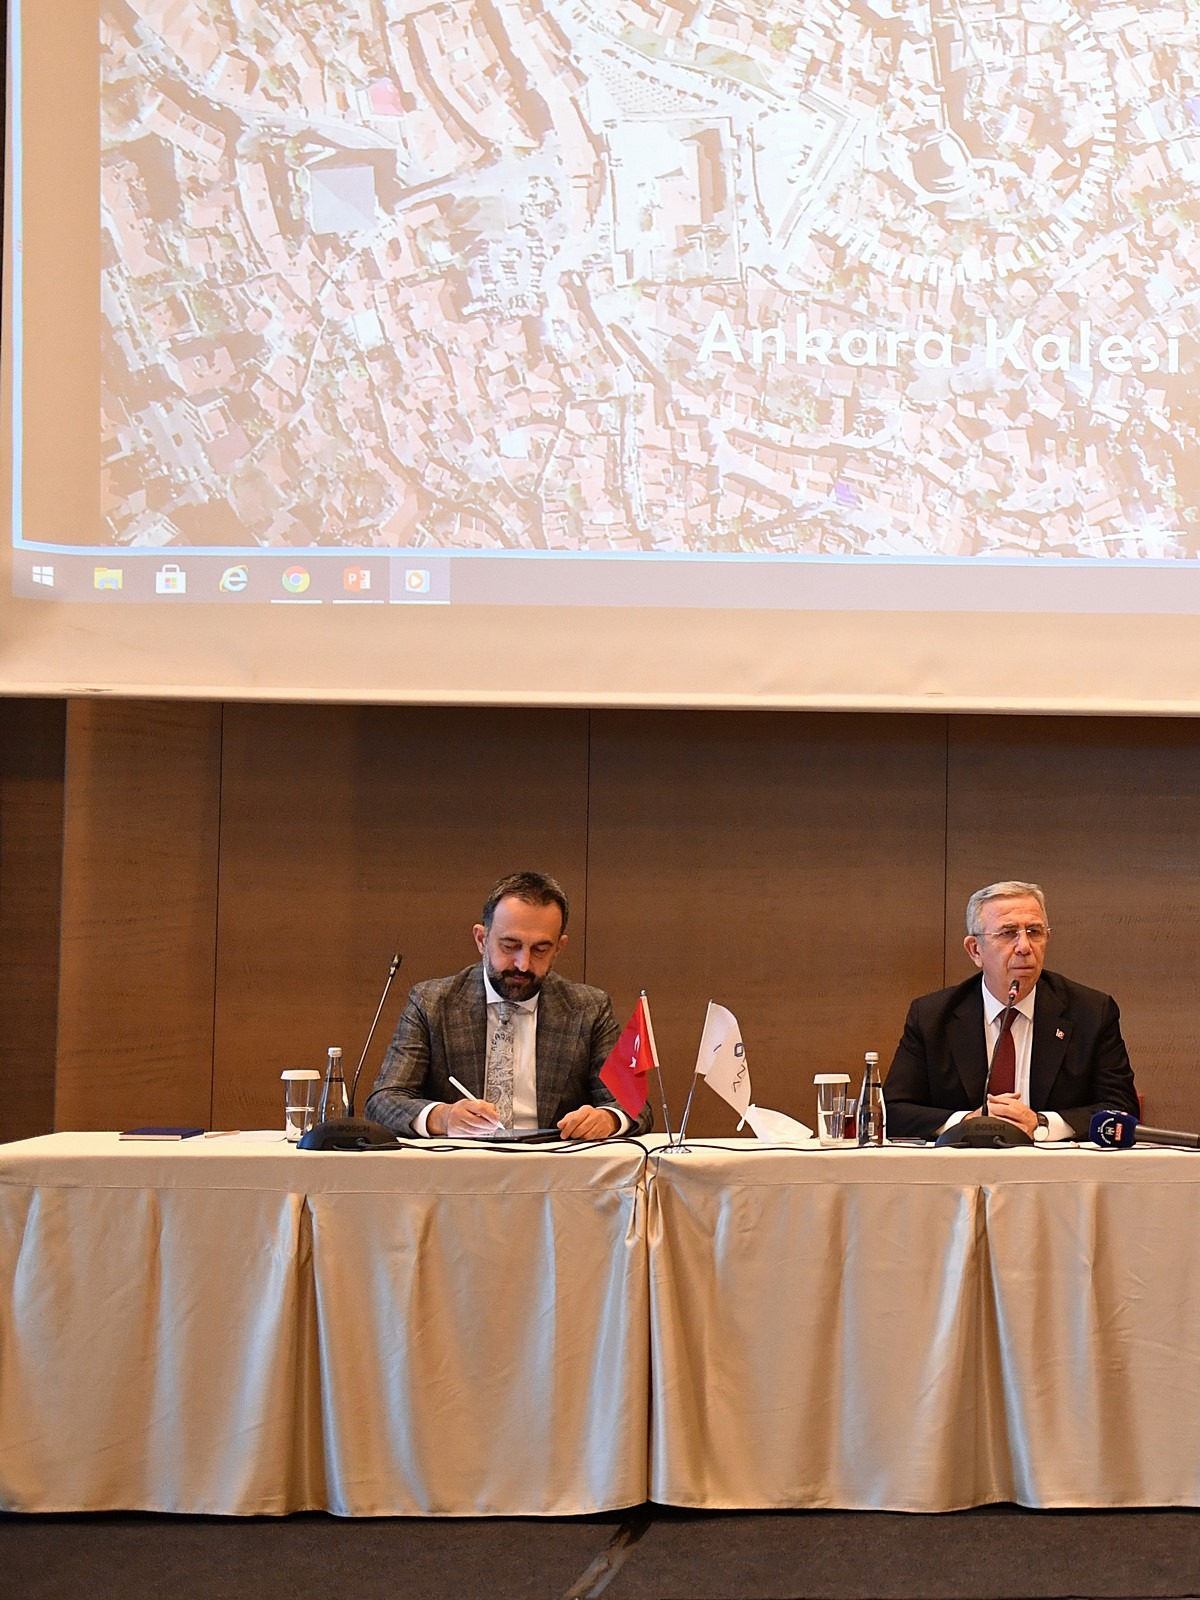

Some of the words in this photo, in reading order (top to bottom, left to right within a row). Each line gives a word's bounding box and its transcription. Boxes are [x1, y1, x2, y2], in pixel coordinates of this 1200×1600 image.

[696, 310, 953, 368] Ankara
[985, 317, 1180, 374] Kalesi
[338, 1124, 370, 1133] BOSCH
[975, 1123, 1006, 1131] BOSCH
